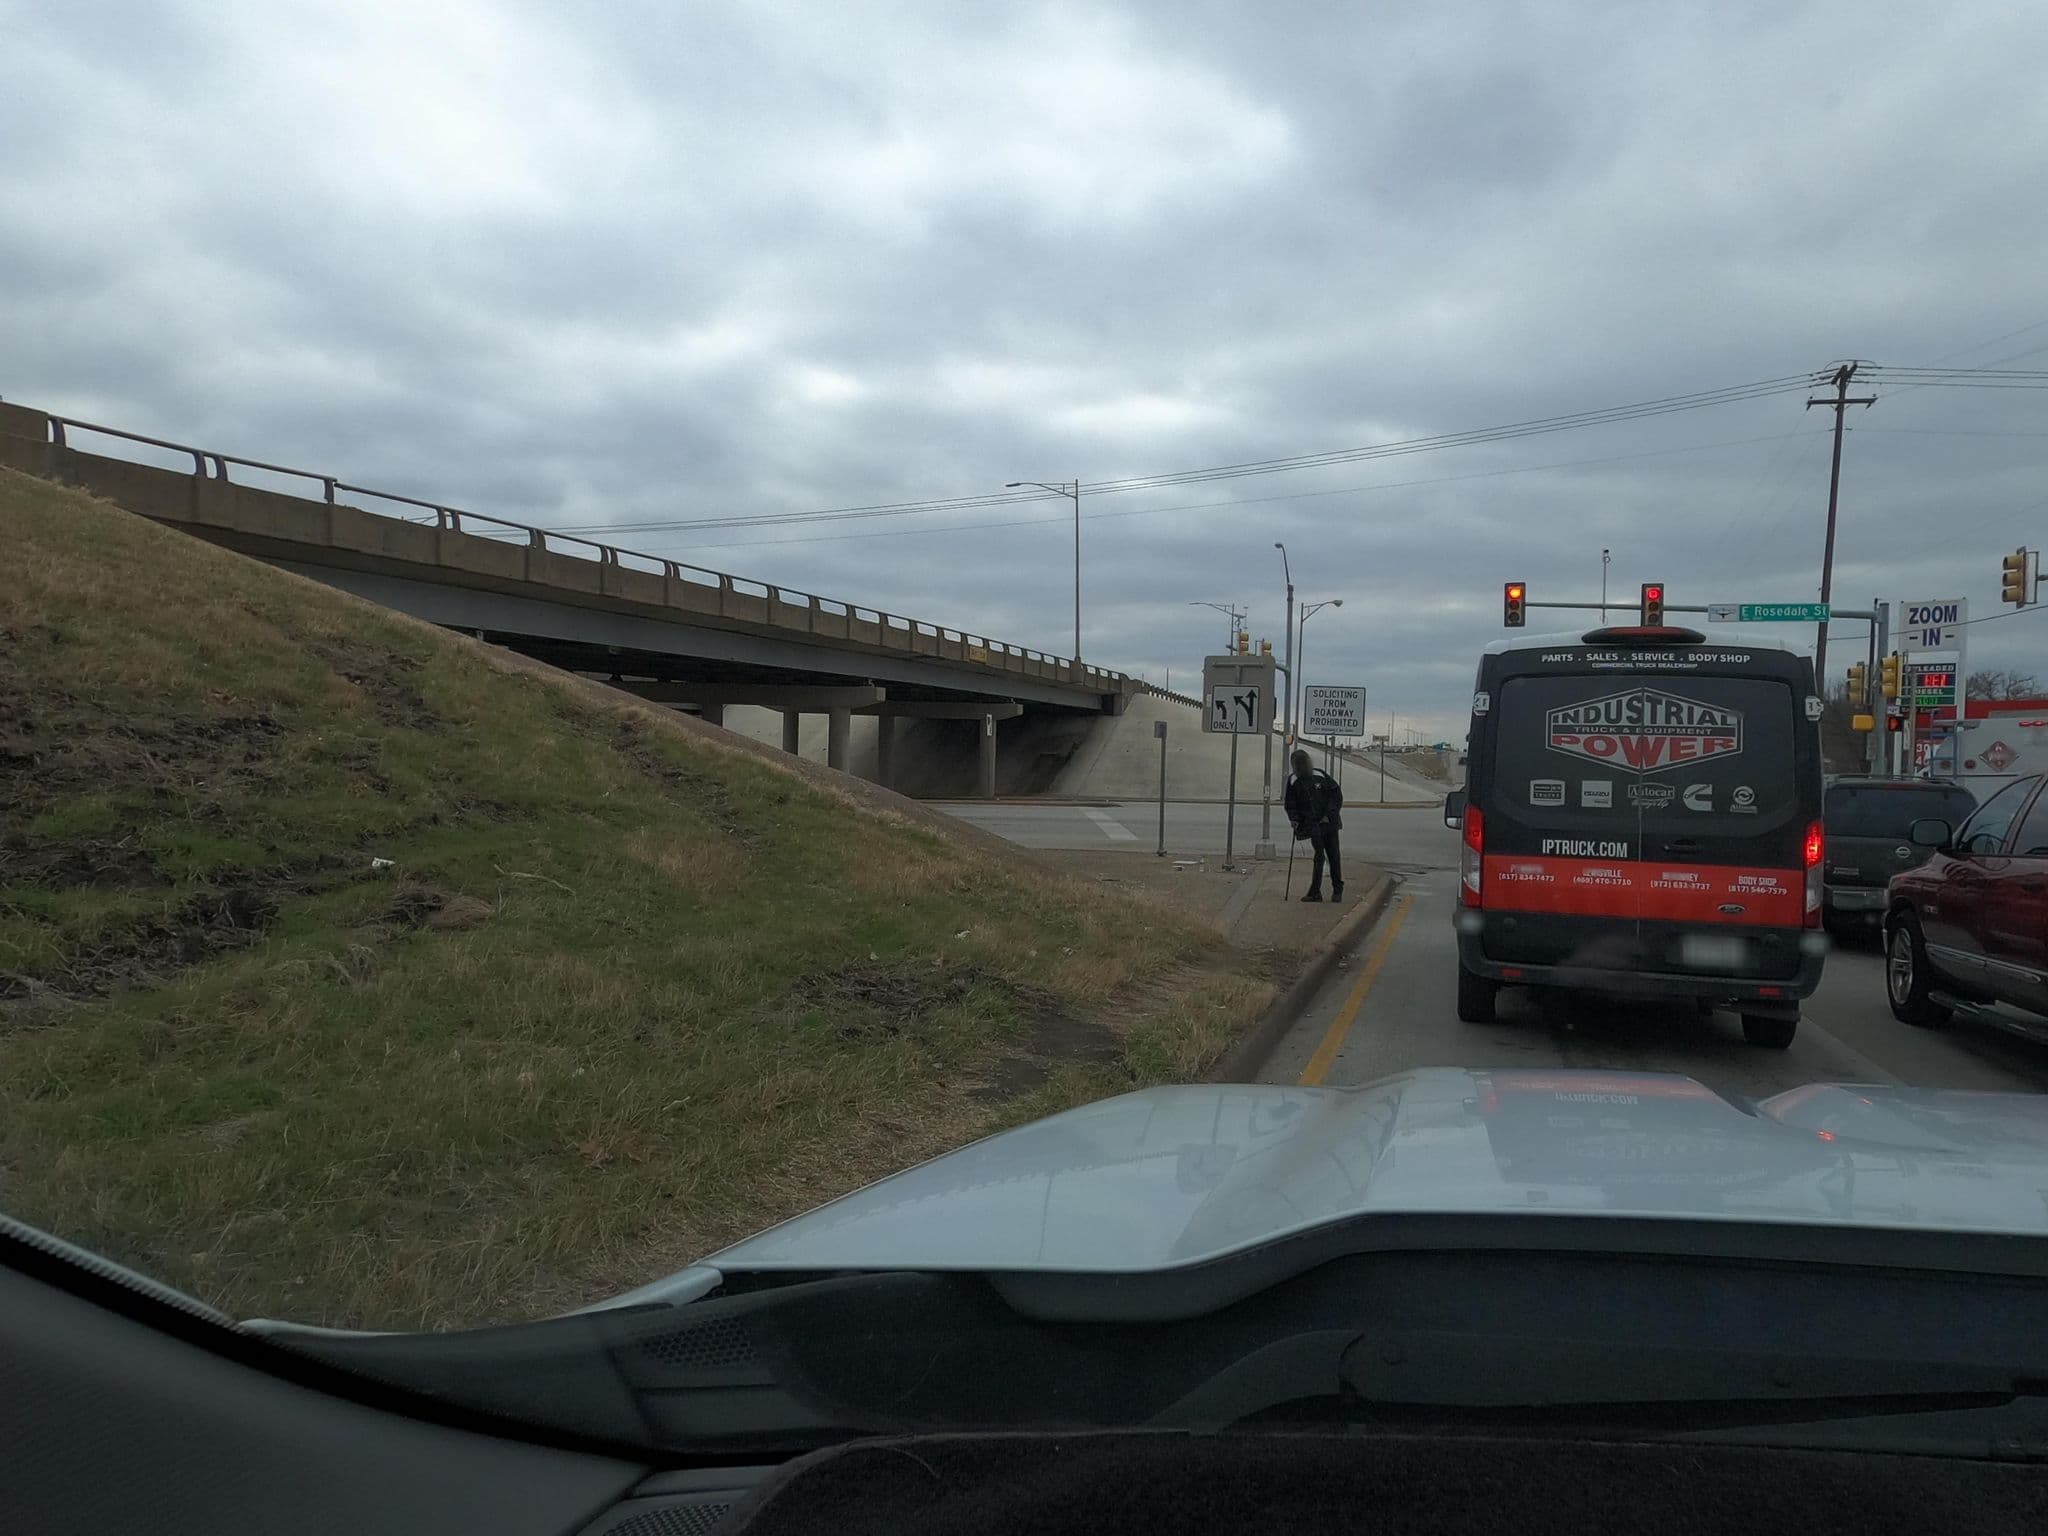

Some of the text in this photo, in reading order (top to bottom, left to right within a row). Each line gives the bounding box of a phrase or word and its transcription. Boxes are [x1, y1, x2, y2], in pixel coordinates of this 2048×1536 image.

[1741, 606, 1749, 617] E
[1754, 606, 1808, 617] Rosedale
[1813, 605, 1826, 616] St
[1909, 605, 1957, 625] ZOOM
[1541, 653, 1750, 663] PARTS SALES SERVICE BODY SHOP
[1313, 689, 1358, 699] SOLICITING
[1323, 699, 1346, 708] FROM
[1314, 708, 1354, 717] ROADWAY
[1552, 695, 1736, 726] INDUSTRIAL
[1213, 720, 1235, 730] ONLY
[1310, 717, 1358, 727] PROHIBITED
[1574, 726, 1617, 734] TRUCK
[1636, 727, 1713, 736] EQUIPMENT
[1551, 735, 1736, 768] POWER
[1542, 839, 1628, 858] IPTRUCK.COM
